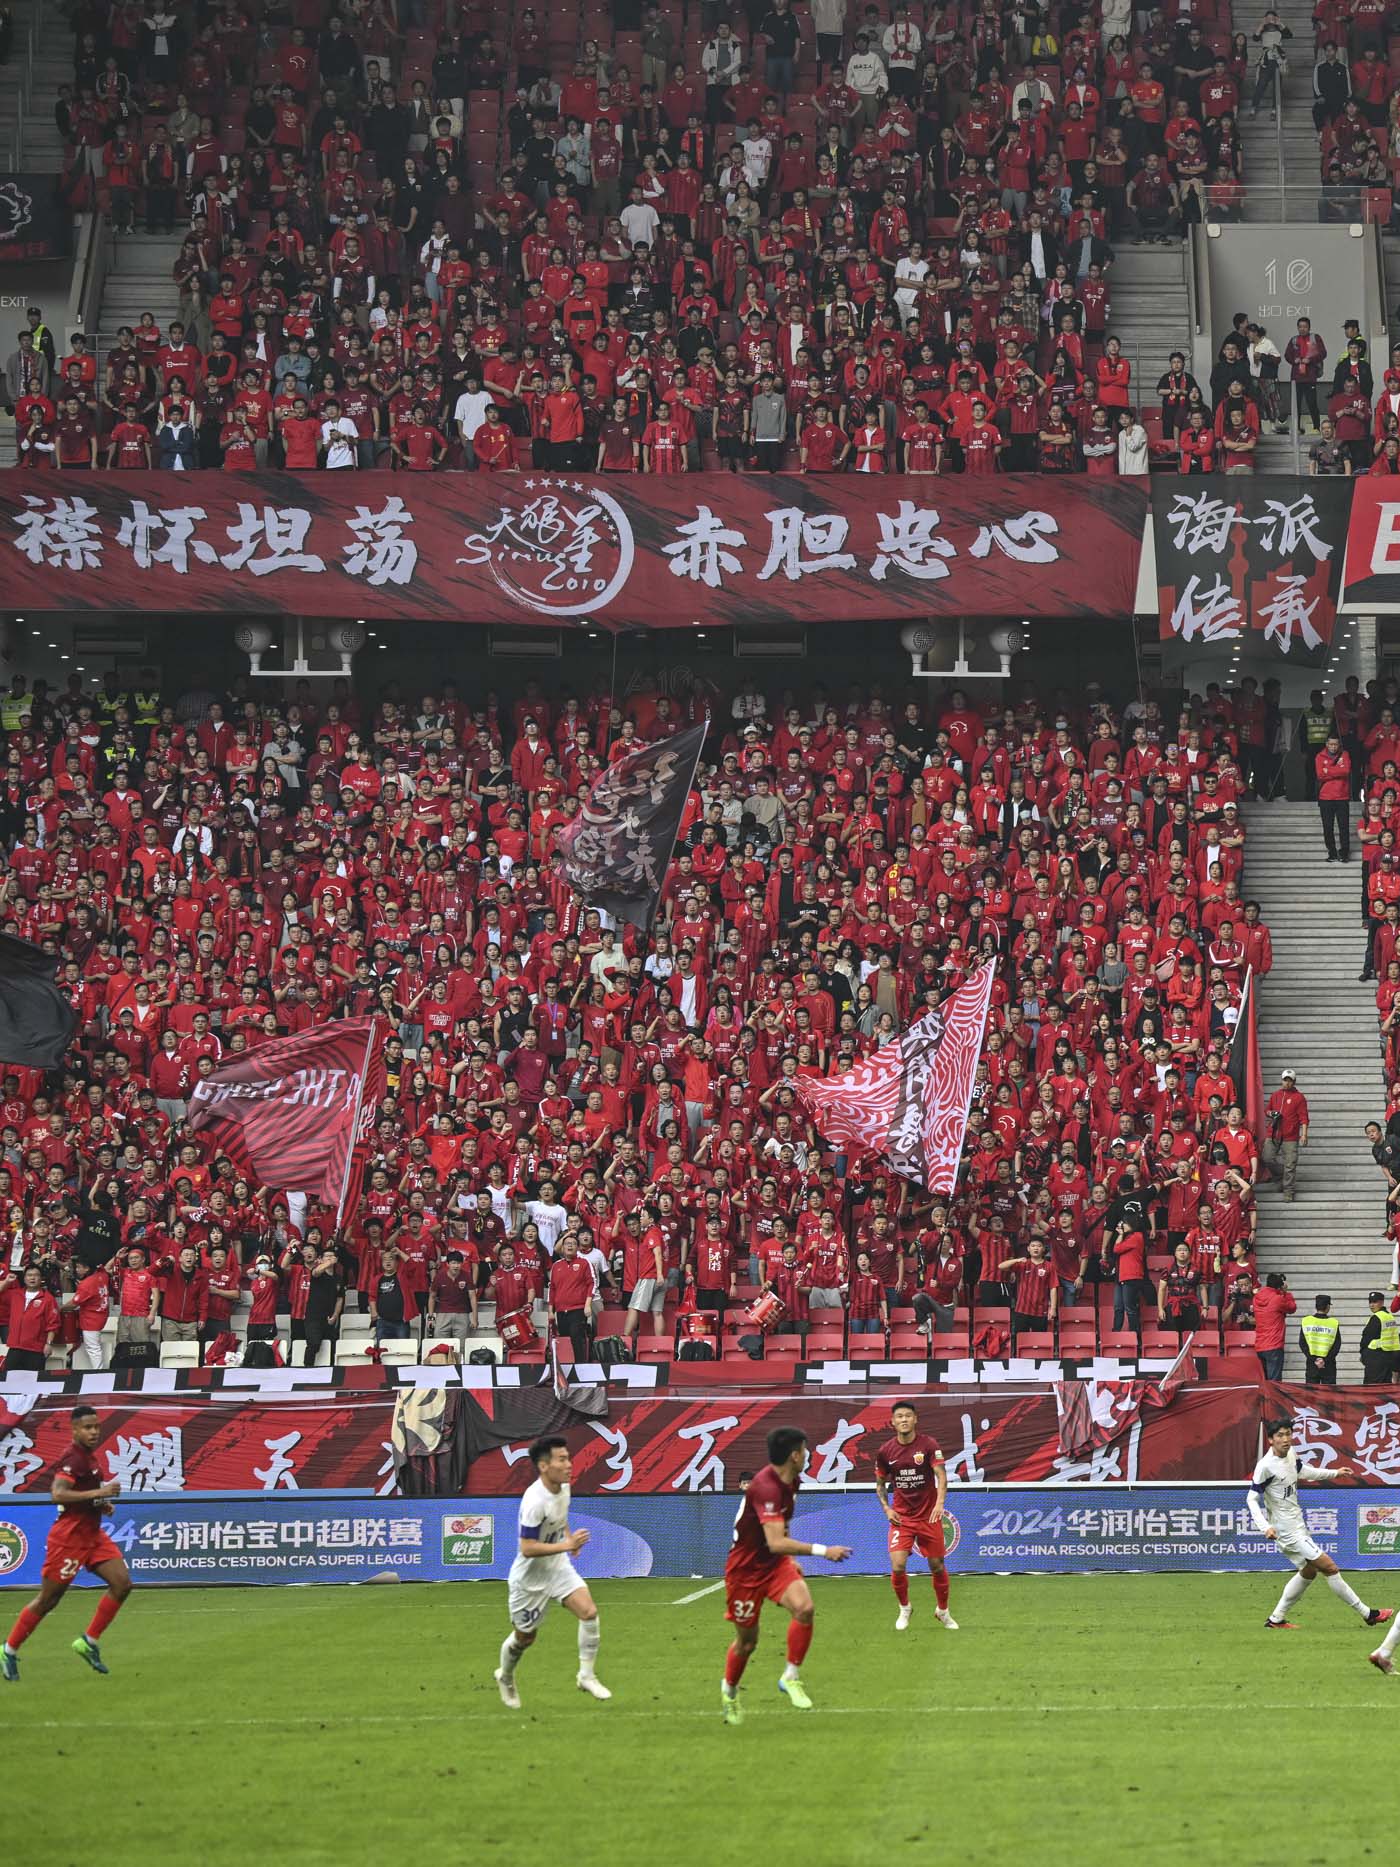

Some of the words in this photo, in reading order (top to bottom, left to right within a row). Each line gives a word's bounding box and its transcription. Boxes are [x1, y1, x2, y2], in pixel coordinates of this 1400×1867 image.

[1264, 258, 1313, 296] 10
[1, 296, 29, 308] EXIT
[1258, 304, 1283, 318] 出口
[1286, 305, 1313, 318] EXIT
[1167, 490, 1334, 562] 海派
[12, 493, 421, 586] 襟怀坦荡
[661, 500, 1060, 590] 赤胆忠心
[1170, 573, 1325, 654] 传承
[976, 1507, 1067, 1538] 2024
[139, 1517, 423, 1551] 华润怡宝中超联赛
[891, 1529, 900, 1544] 2
[979, 1545, 1013, 1557] 2024
[1016, 1544, 1057, 1557] CHINA
[1060, 1544, 1140, 1557] RESOURCES
[1143, 1543, 1211, 1556] C'ESTBON
[1212, 1542, 1237, 1555] CFA
[60, 1558, 80, 1576] 22
[131, 1556, 217, 1569] RESOURCES
[219, 1555, 288, 1568] C'ESTBON
[292, 1555, 316, 1567] CFA
[319, 1554, 365, 1566] SUPER
[367, 1553, 422, 1565] LEAGUE
[521, 1607, 542, 1624] 30
[733, 1600, 755, 1618] 32
